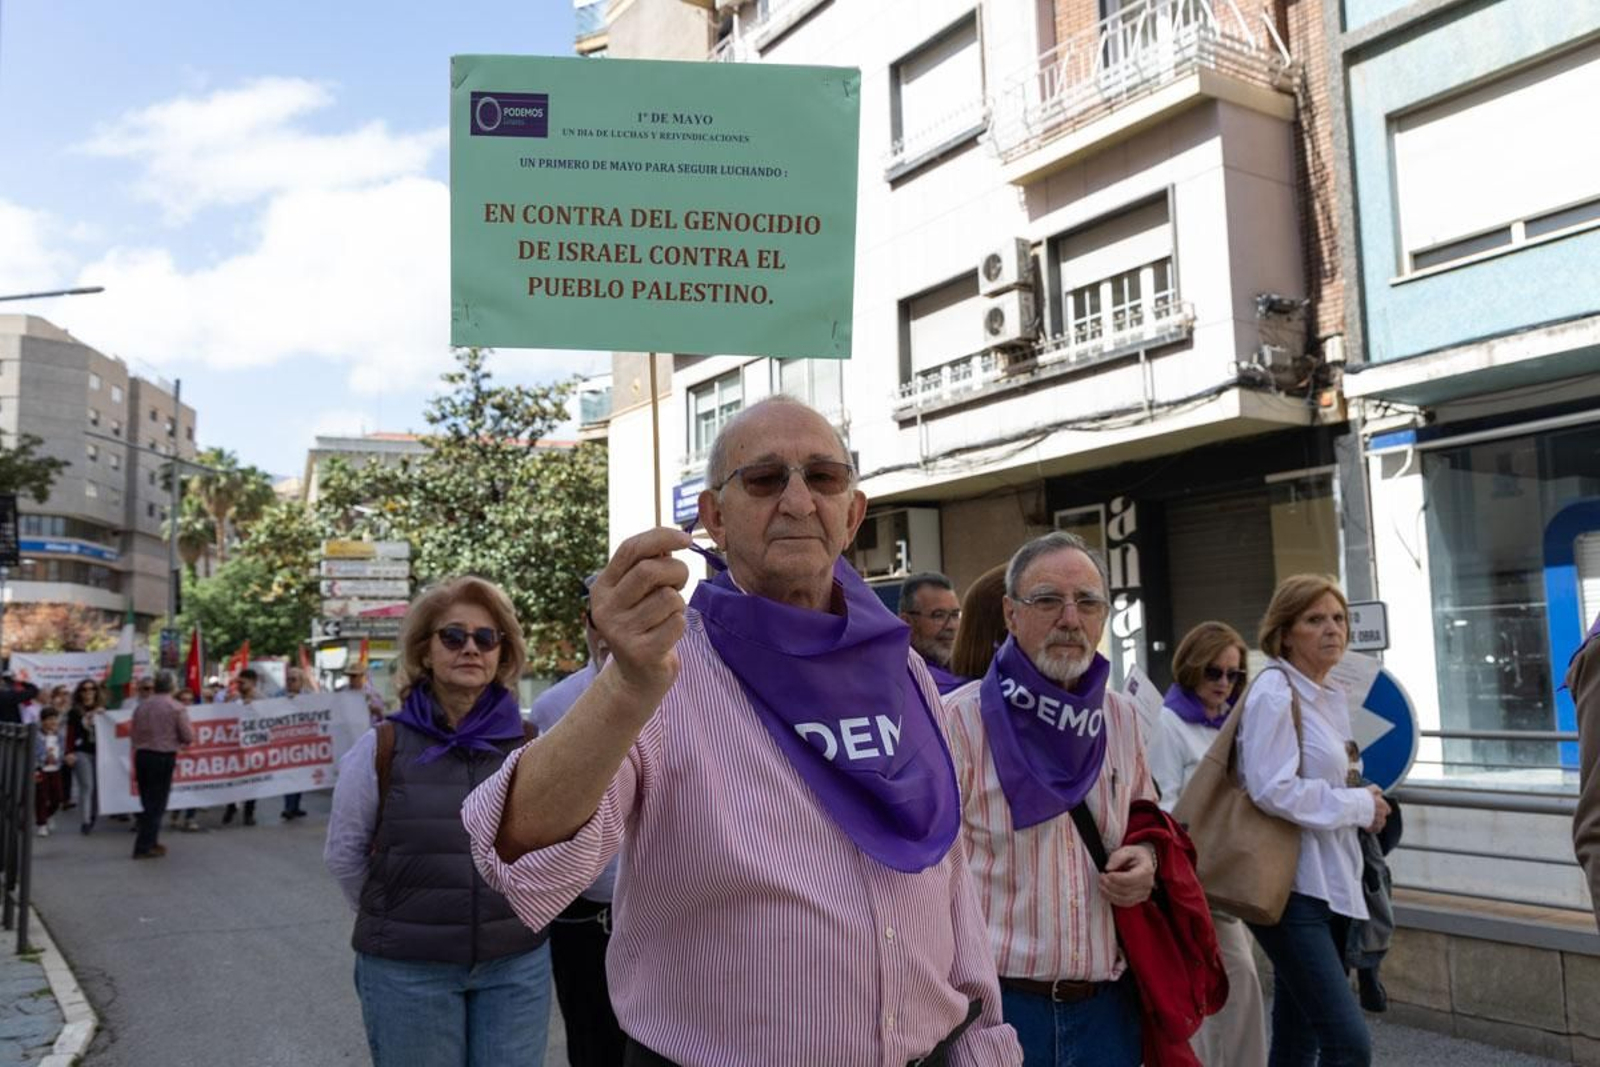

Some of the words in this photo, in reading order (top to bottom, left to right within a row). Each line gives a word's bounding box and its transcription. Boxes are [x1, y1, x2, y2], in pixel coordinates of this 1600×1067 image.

[503, 107, 544, 118] PODEMOS
[650, 112, 669, 124] DE
[672, 113, 713, 125] MAYO
[562, 128, 575, 137] UN
[577, 128, 594, 138] DIA
[596, 129, 609, 138] DE
[611, 130, 649, 140] LUCHAS
[651, 131, 657, 140] Y
[659, 131, 750, 143] REIVINDICACIONES
[520, 158, 536, 168] UN
[539, 158, 590, 171] PRIMERO
[592, 160, 607, 170] DE
[609, 160, 643, 172] MAYO
[645, 162, 676, 173] PARA
[677, 163, 718, 175] SEGUIR
[720, 165, 782, 178] LUCHANDO
[484, 203, 515, 223] EN
[522, 204, 623, 228] CONTRA
[630, 208, 678, 230] DEL
[683, 210, 821, 236] GENOCIDIO
[518, 240, 550, 261] DE
[556, 241, 642, 264] ISRAEL
[649, 245, 750, 269] CONTRA
[756, 249, 786, 271] EL
[528, 276, 624, 299] PUEBLO
[631, 280, 774, 305] PALESTINO.
[1358, 629, 1381, 642] OBRA
[242, 719, 257, 732] SE
[259, 709, 331, 730] CONSTRUYE
[198, 724, 241, 745] PAZ
[243, 731, 268, 747] CON
[320, 723, 329, 734] Y
[267, 742, 333, 768] DIGNO
